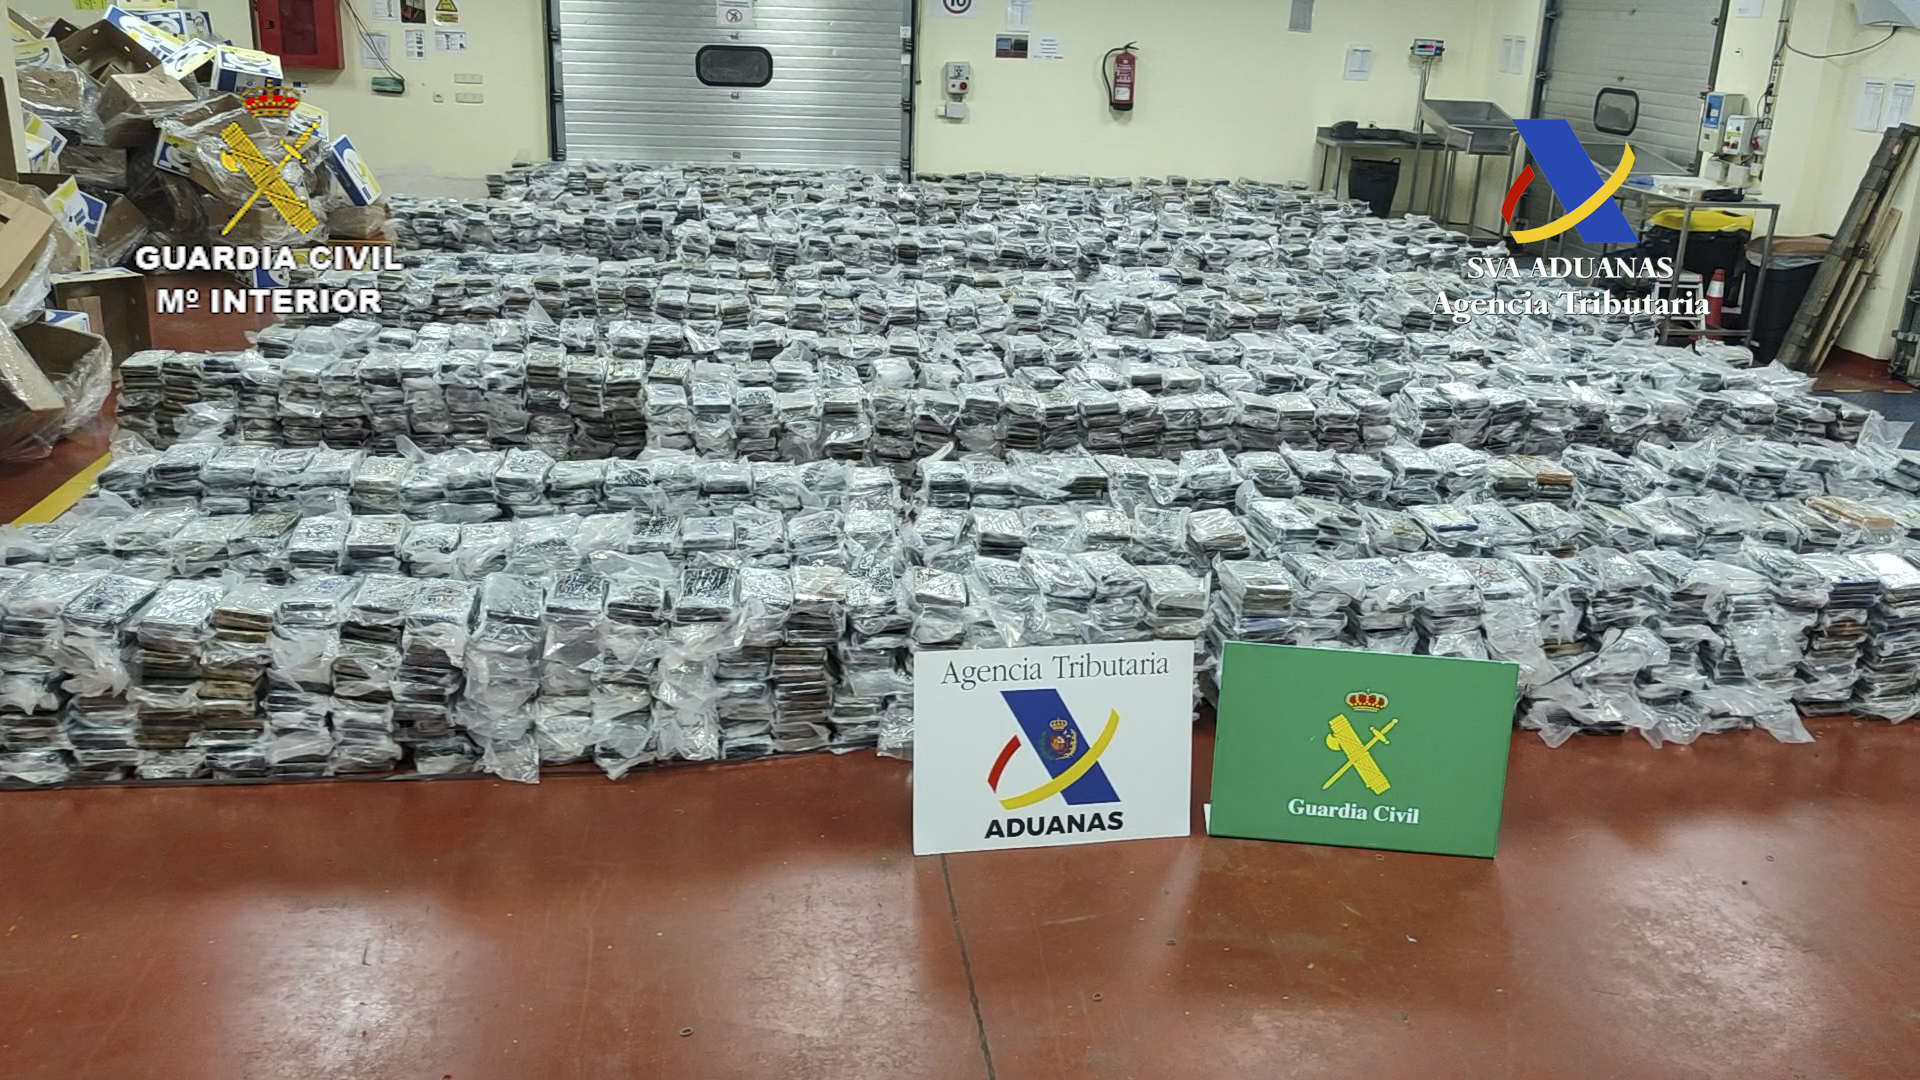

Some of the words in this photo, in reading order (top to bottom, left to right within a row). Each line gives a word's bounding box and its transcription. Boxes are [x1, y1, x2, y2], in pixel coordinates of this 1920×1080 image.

[940, 657, 1043, 690] Agencia
[1051, 651, 1170, 680] Tributaria
[984, 811, 1125, 839] ADUANAS
[1287, 797, 1369, 821] Guardia
[1373, 804, 1420, 825] Civil
